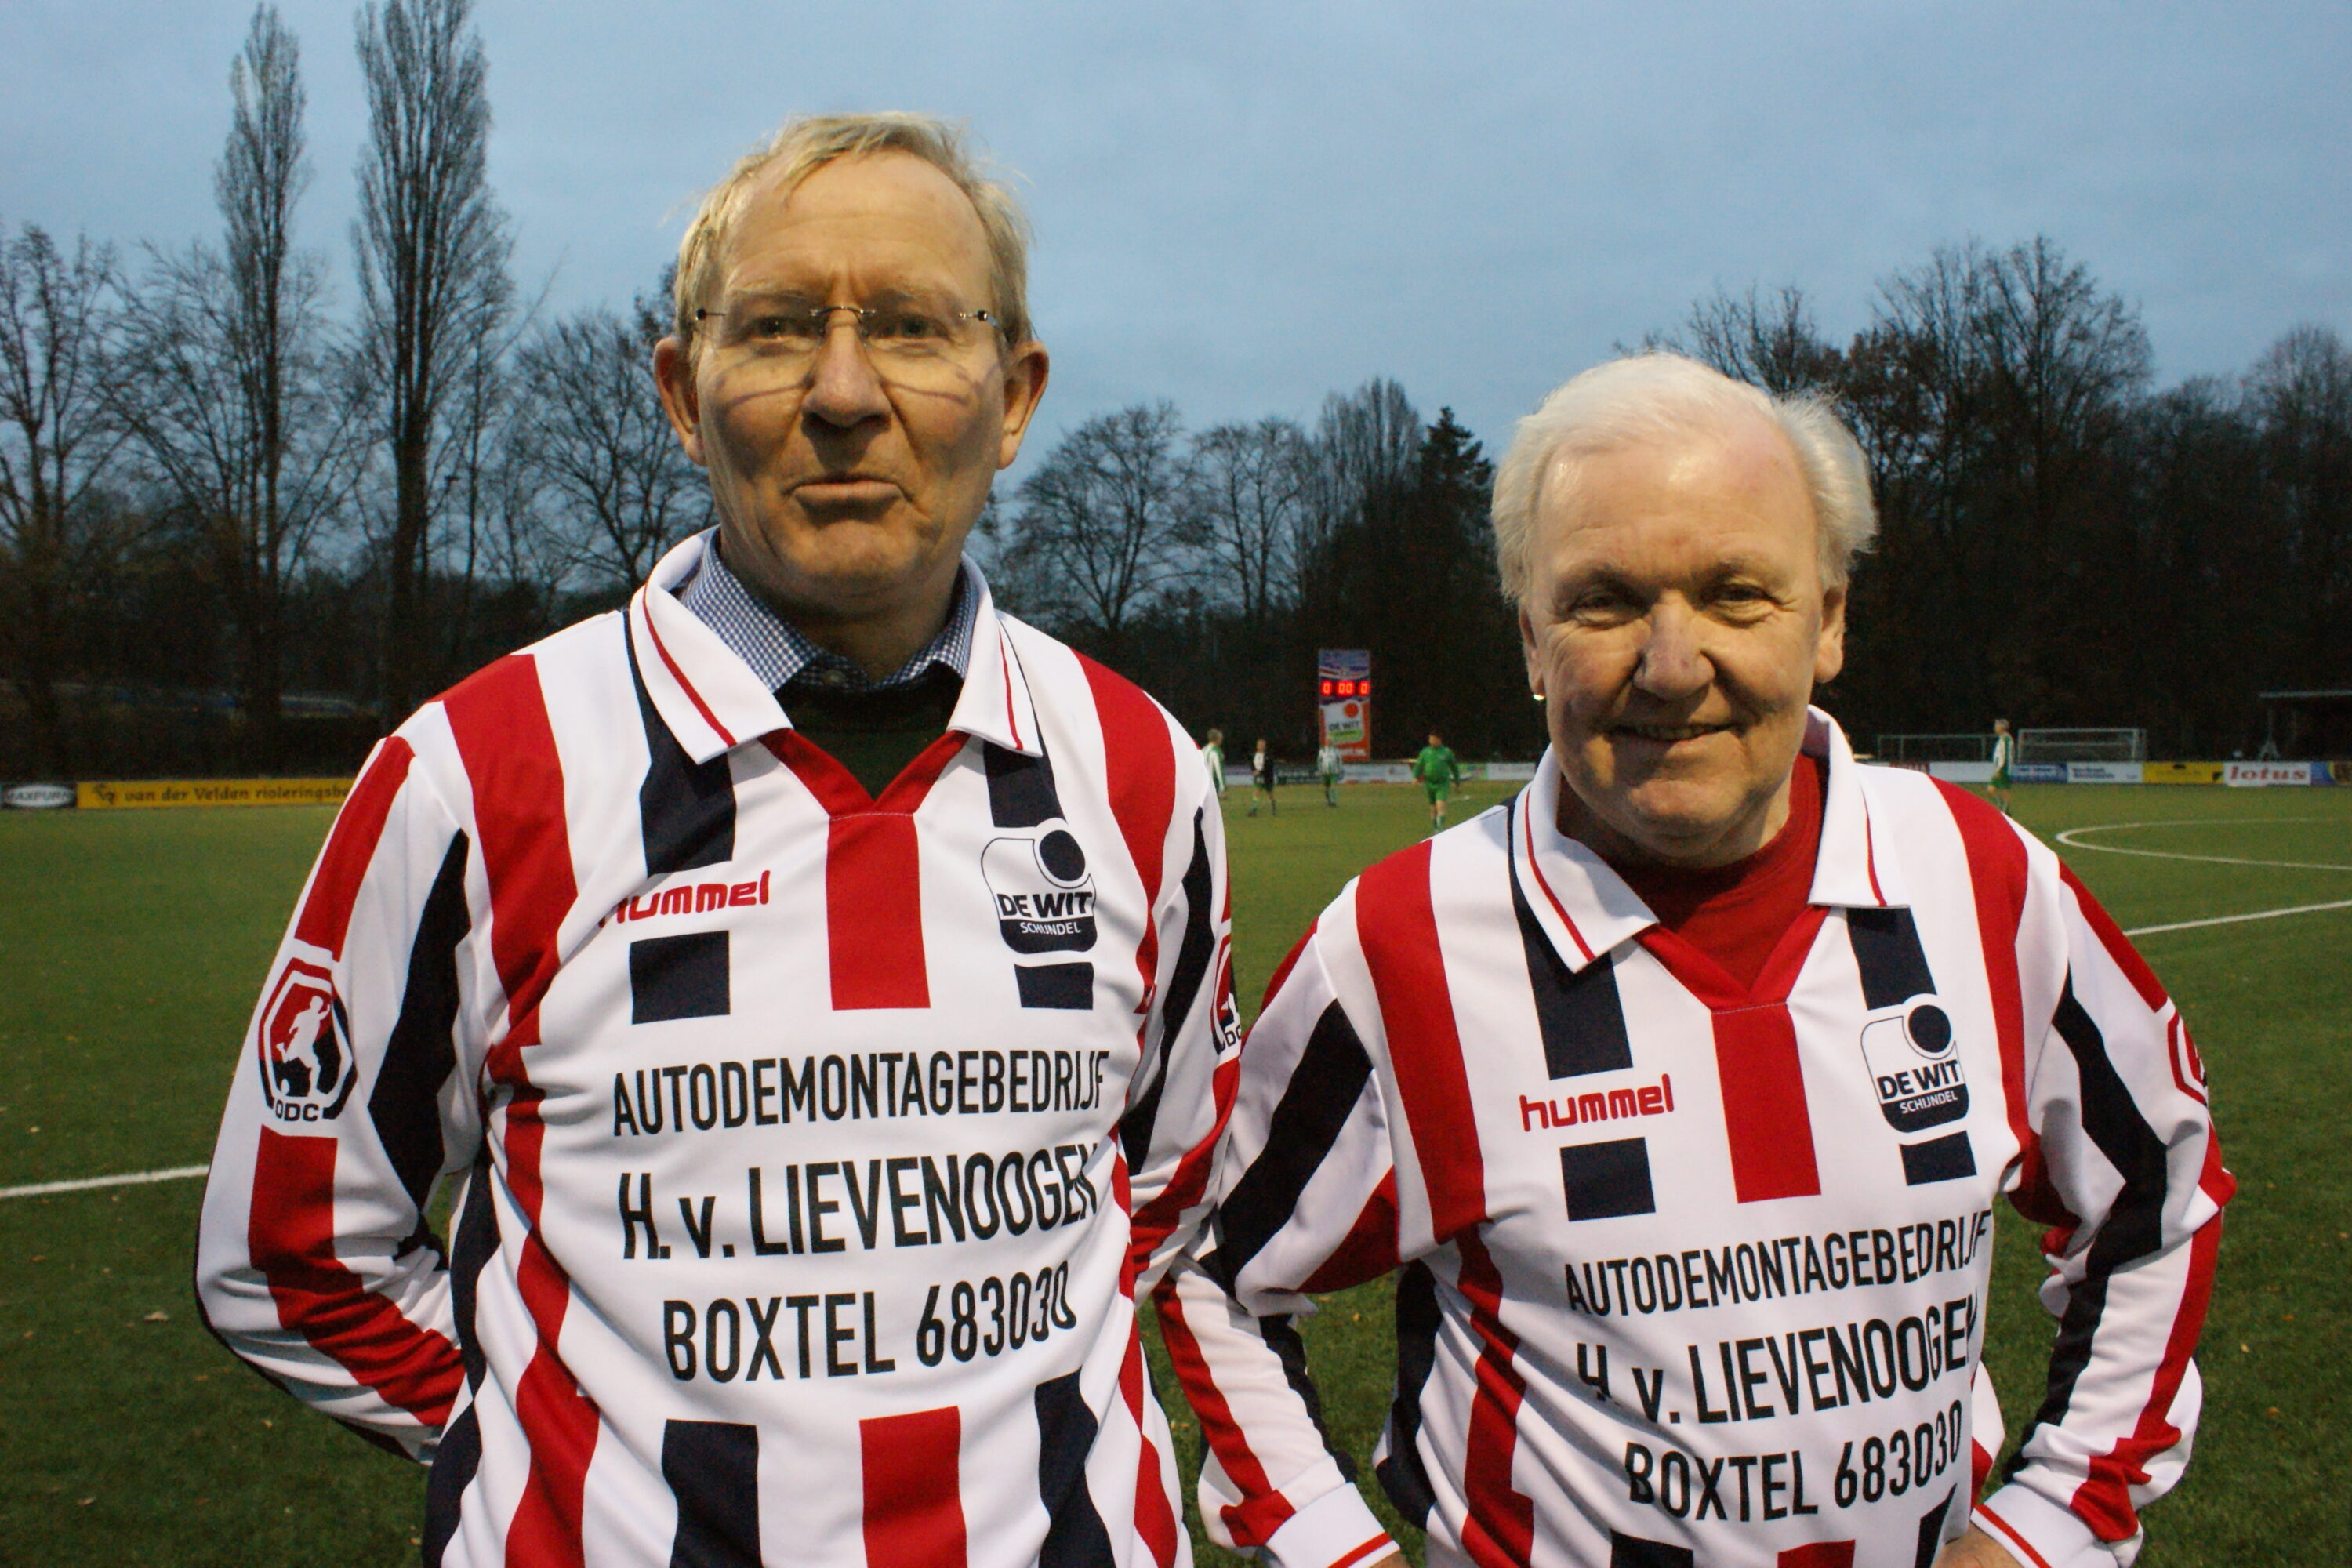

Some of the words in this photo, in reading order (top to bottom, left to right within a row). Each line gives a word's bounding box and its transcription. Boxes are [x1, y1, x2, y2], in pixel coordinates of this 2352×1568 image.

[2230, 766, 2307, 780] lotus
[124, 792, 155, 801] van
[161, 786, 188, 800] der
[194, 786, 249, 800] Velden
[996, 893, 1032, 918] DE
[1033, 891, 1093, 918] WIT
[1020, 921, 1082, 935] SCHIJNDEL
[613, 1050, 1109, 1137] AUTODEMONTAGEBEDRIJF
[1877, 1071, 1915, 1100] DE
[1911, 1059, 1960, 1091] WIT
[275, 1099, 320, 1122] ODC
[1519, 1073, 1675, 1132] hummel
[1900, 1090, 1958, 1114] SCHIJNDEL
[1564, 1210, 1992, 1316] AUTODEMONTAGEBEDRIJF
[662, 1291, 896, 1384] BOXTEL
[916, 1259, 1077, 1367] 683030
[1624, 1441, 1819, 1523] BOXTEL
[1834, 1399, 1962, 1508] 683030
